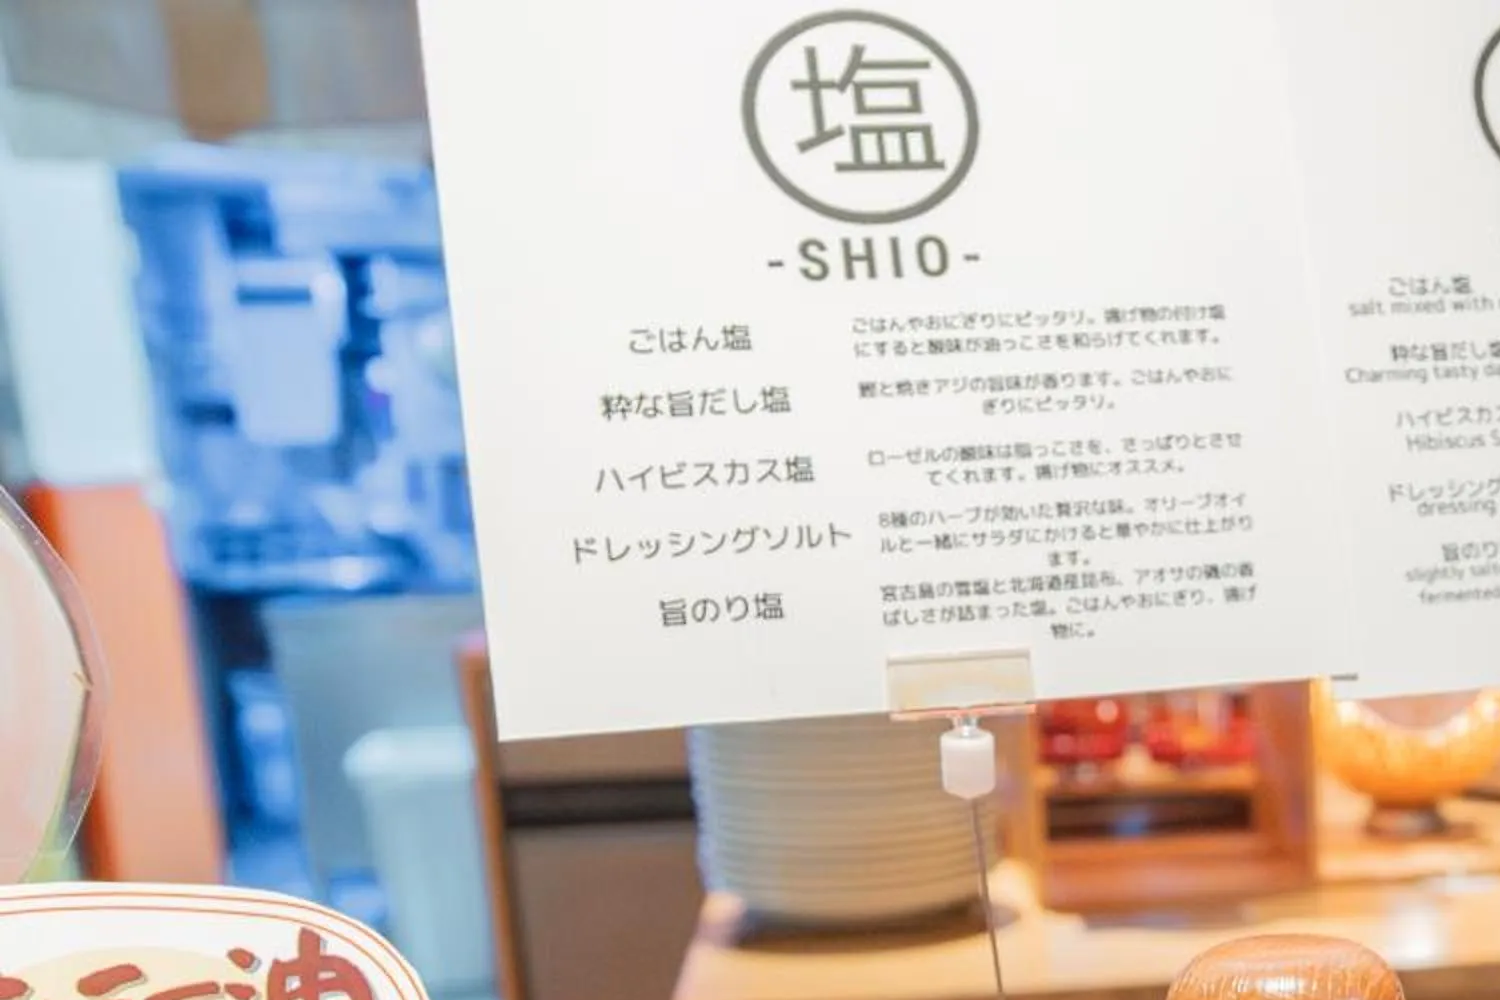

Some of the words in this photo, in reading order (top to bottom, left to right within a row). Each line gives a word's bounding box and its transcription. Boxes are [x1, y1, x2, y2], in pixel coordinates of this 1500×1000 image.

[791, 44, 946, 172] 塩
[1348, 300, 1385, 317] salt
[1390, 298, 1446, 315] mixed
[1451, 297, 1494, 312] with
[629, 324, 753, 353] ごはん塩
[1345, 366, 1428, 383] Charming
[1433, 364, 1478, 381] tasty
[599, 386, 792, 420] 粋な旨だし塩
[1406, 434, 1486, 452] Hibiscus
[596, 456, 815, 491] ハイビスカス塩
[1417, 499, 1496, 518] dressing
[573, 523, 852, 564] ドレッシングソルト
[659, 593, 784, 627] 旨のり塩
